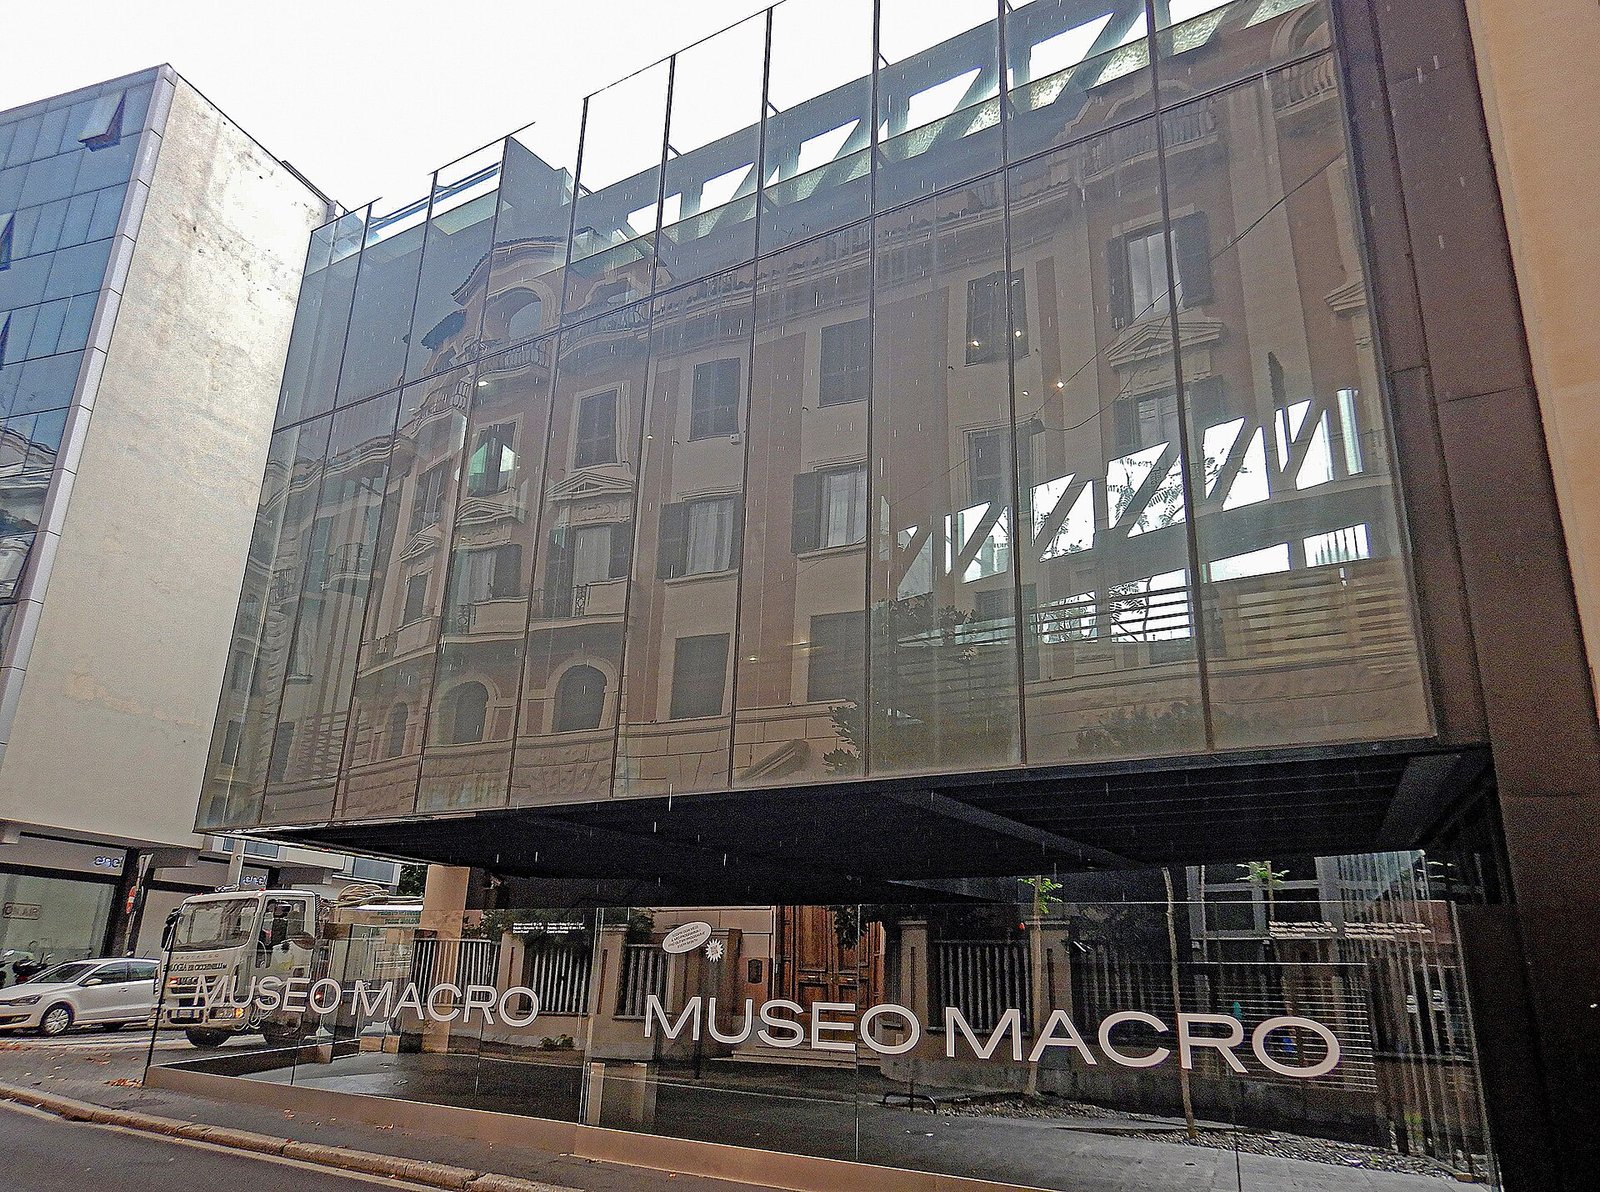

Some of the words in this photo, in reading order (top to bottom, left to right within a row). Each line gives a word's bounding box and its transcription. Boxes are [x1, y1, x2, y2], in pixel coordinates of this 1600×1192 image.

[193, 975, 342, 1014] MUSEO
[350, 979, 540, 1028] MACRO
[643, 994, 921, 1056] MUSEO
[945, 1006, 1342, 1078] MACRO
